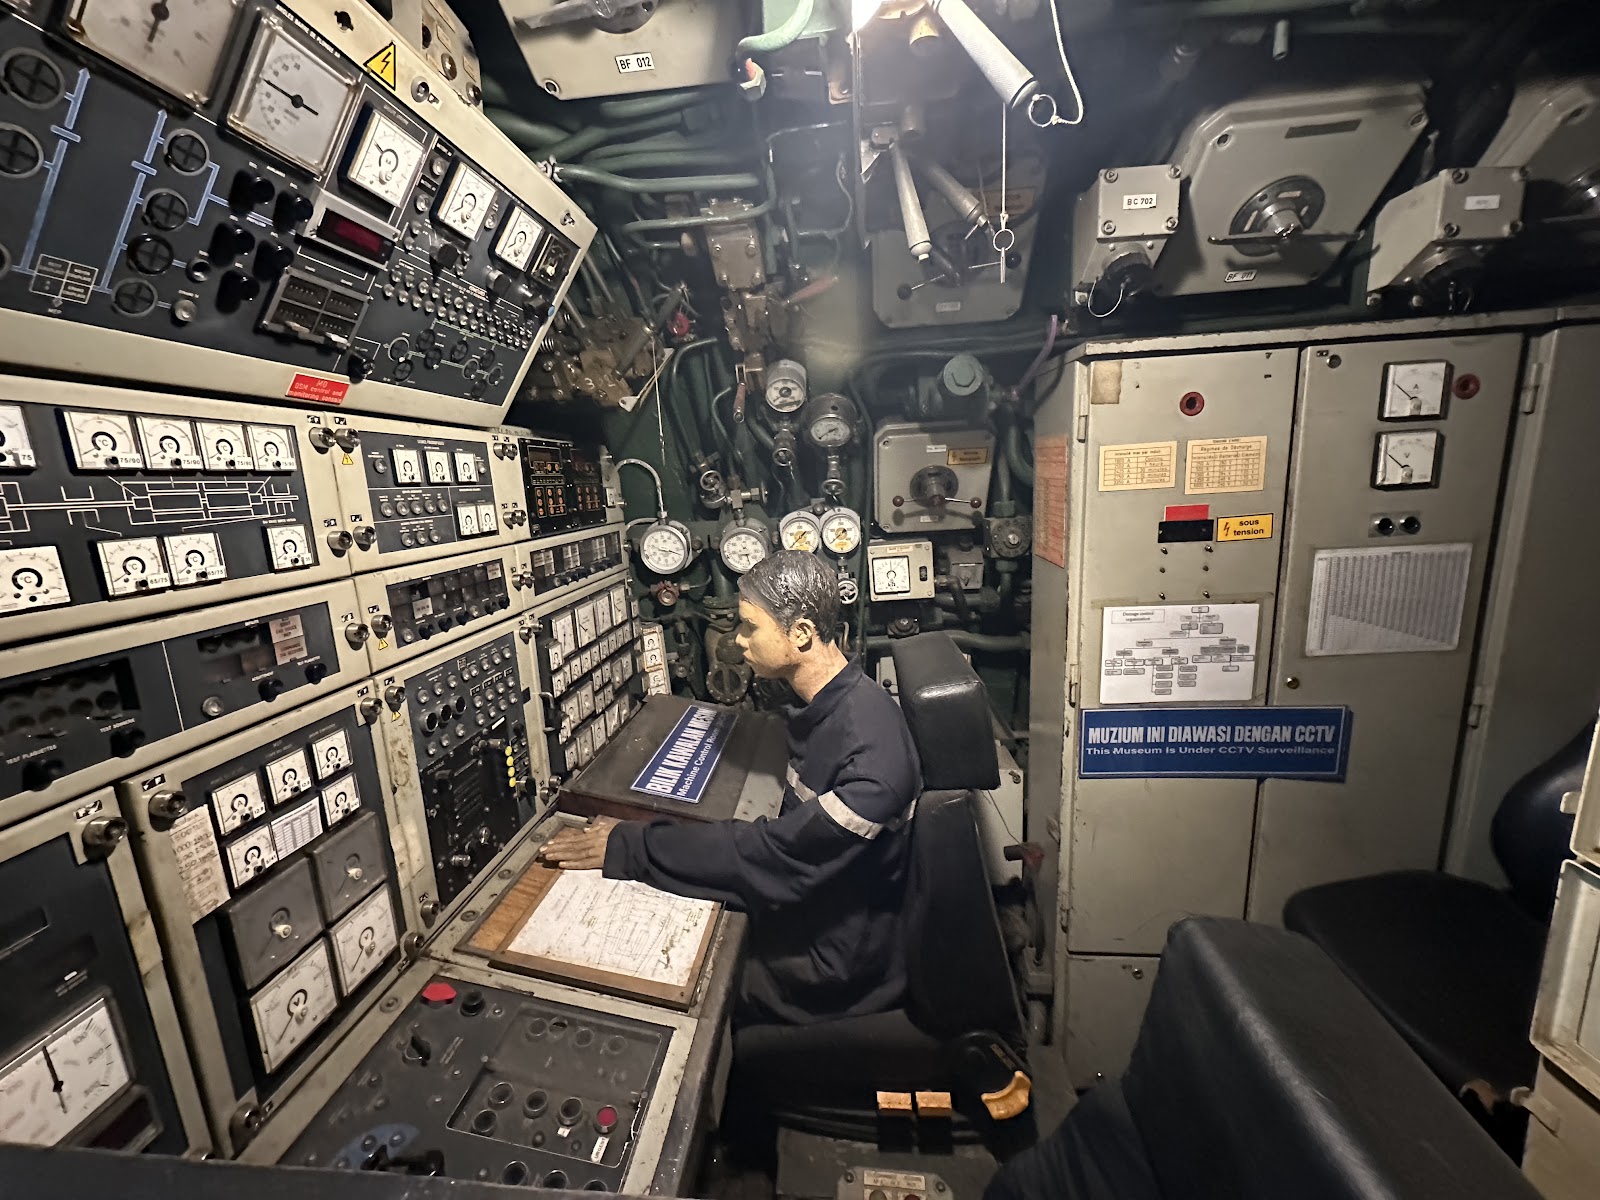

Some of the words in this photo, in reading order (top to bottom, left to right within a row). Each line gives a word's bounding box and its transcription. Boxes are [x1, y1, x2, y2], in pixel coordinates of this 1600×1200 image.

[619, 58, 631, 70] BF
[636, 56, 652, 68] 012
[1127, 198, 1138, 206] BC
[1140, 197, 1154, 205] 702
[1226, 272, 1239, 281] BF
[288, 390, 320, 401] monitoring
[310, 386, 331, 395] control
[1233, 528, 1264, 536] tension
[149, 577, 169, 586] 65/75
[1088, 726, 1144, 744] MUZIUM
[1147, 726, 1166, 743] INI
[1168, 725, 1231, 743] DIAWASI
[1234, 725, 1292, 743] DENGAN
[1295, 725, 1335, 743] CCTV
[661, 727, 707, 769] KAWALAN
[1086, 747, 1110, 755] This
[1113, 747, 1162, 755] Museum
[1179, 746, 1216, 754] Under
[1219, 746, 1255, 754] CCTV
[1257, 746, 1336, 754] Surveillance
[6, 755, 21, 765] TEST
[676, 766, 700, 797] Machine
[694, 743, 713, 766] Control
[645, 766, 683, 794] BILIK
